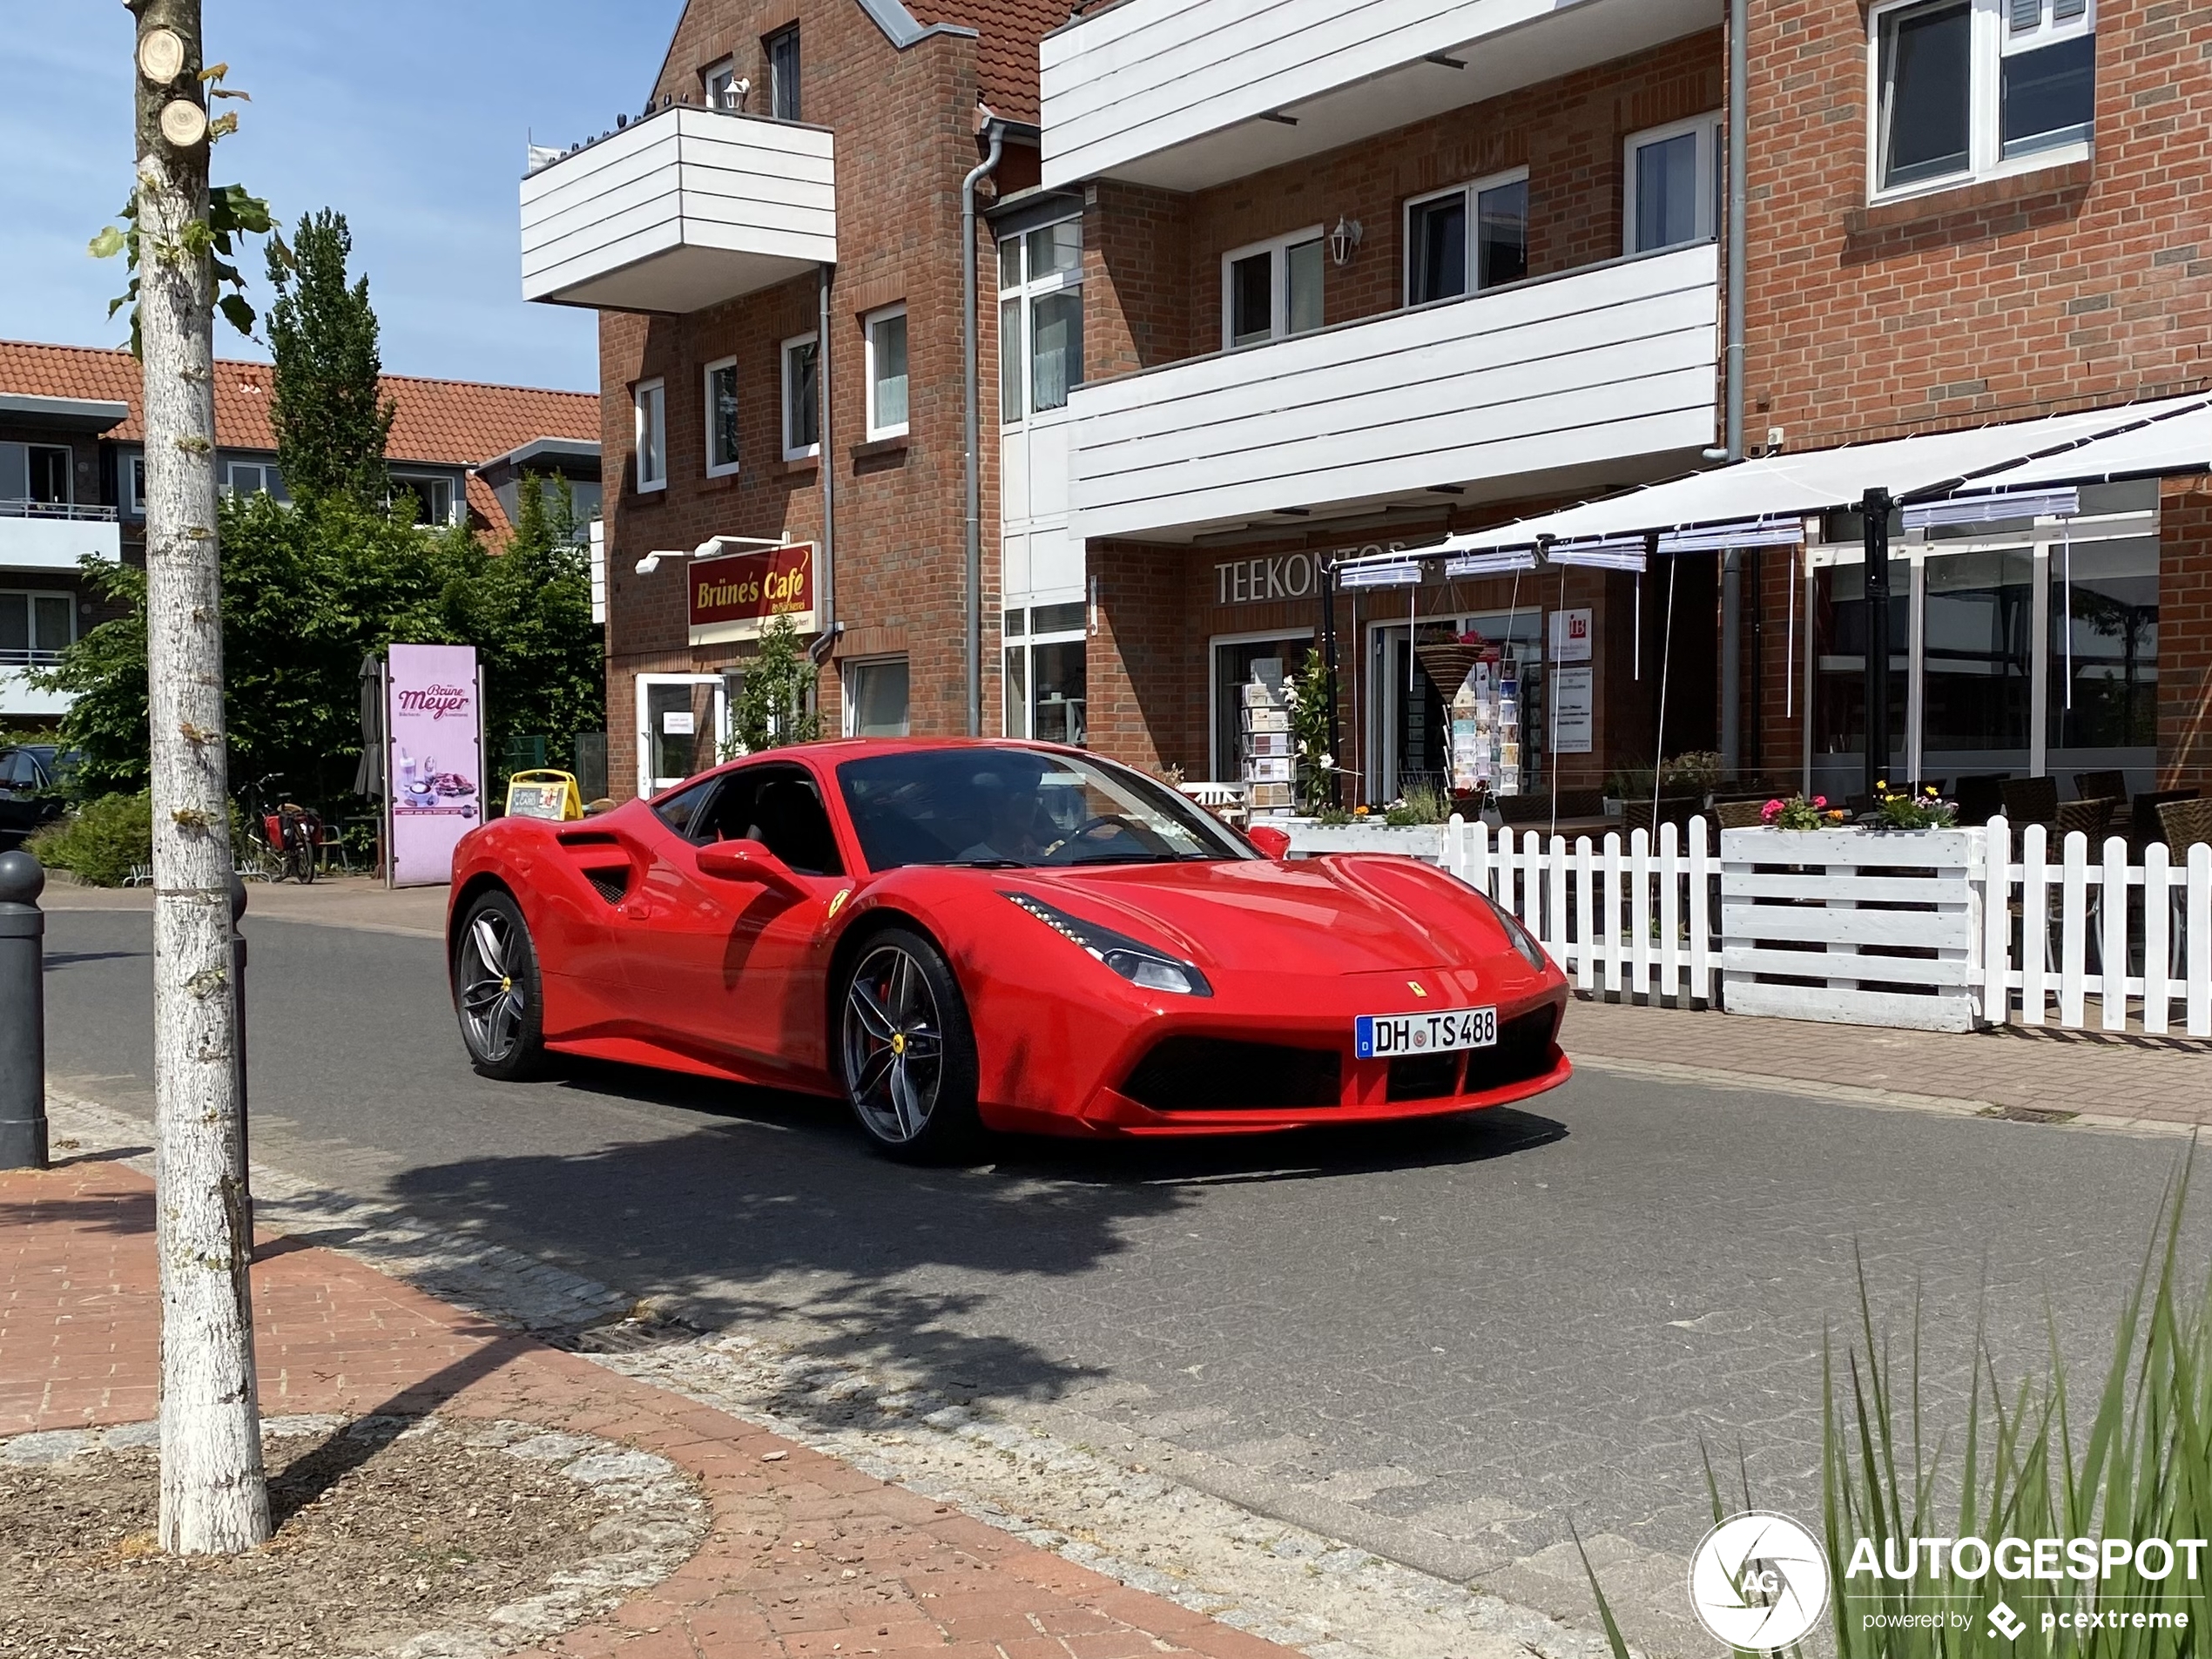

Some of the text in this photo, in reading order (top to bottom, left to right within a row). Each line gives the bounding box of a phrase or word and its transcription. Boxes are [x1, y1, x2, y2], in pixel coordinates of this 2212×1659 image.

[698, 571, 759, 610] Brüne's
[1215, 542, 1406, 604] TEEKON
[399, 691, 469, 720] Meyer
[1376, 1019, 1409, 1052] DH
